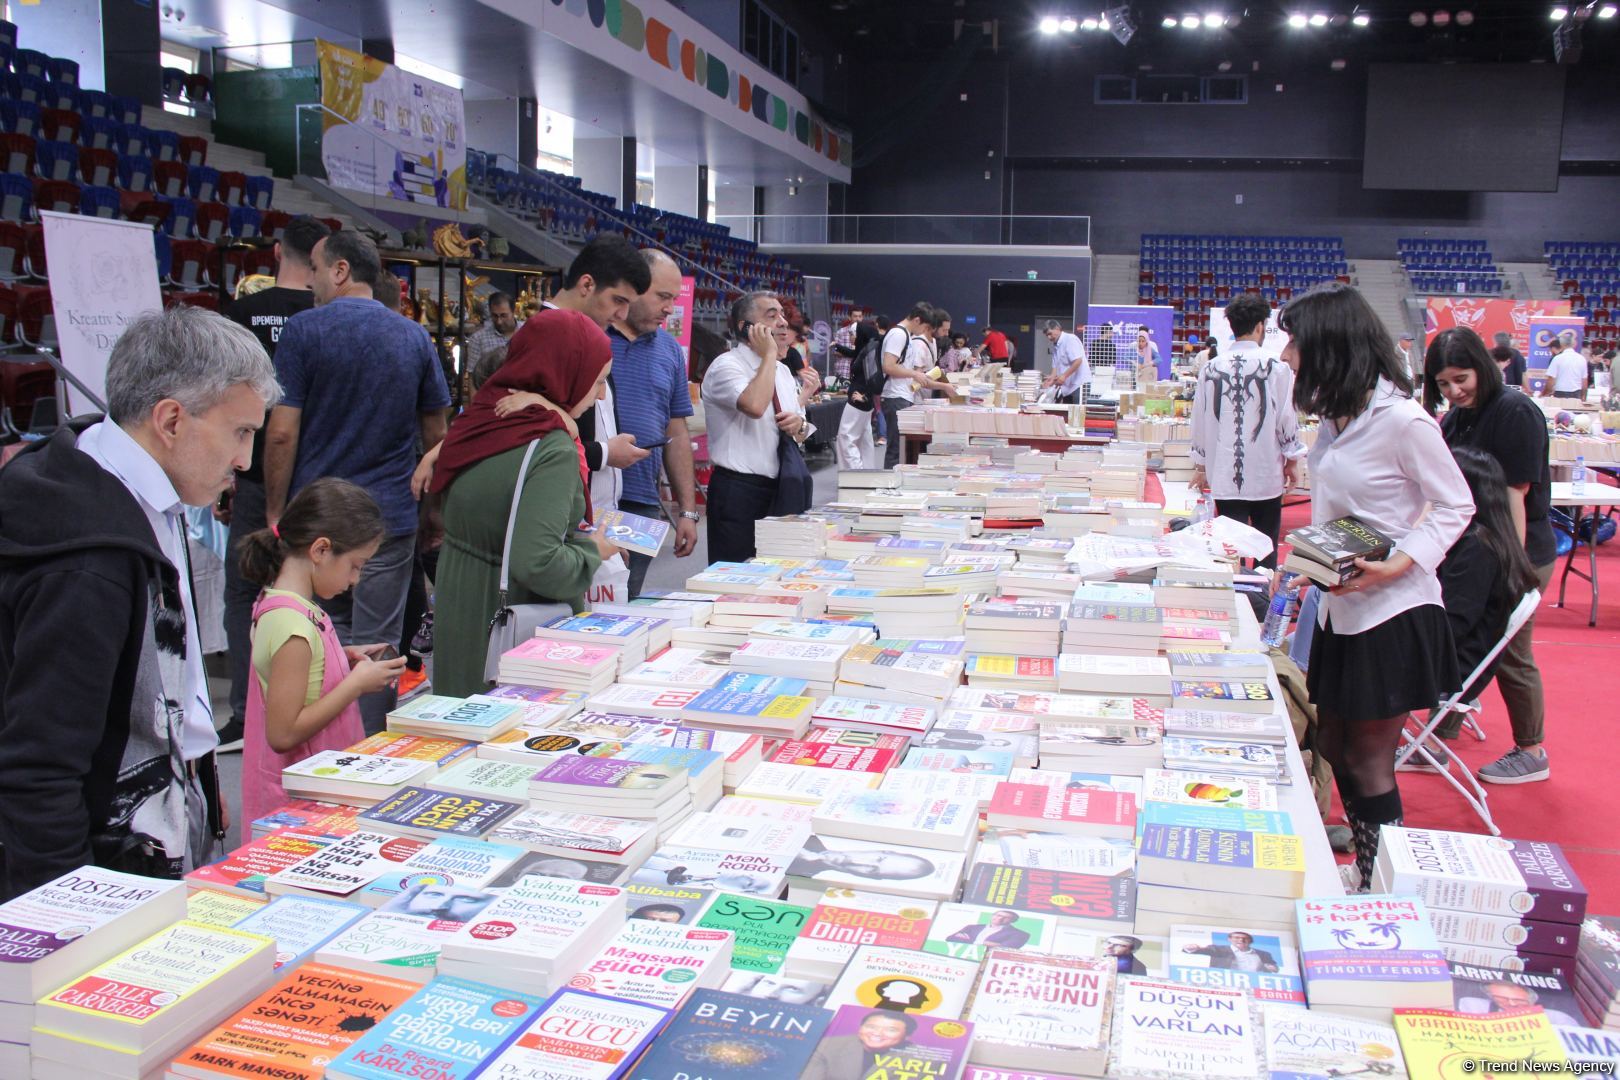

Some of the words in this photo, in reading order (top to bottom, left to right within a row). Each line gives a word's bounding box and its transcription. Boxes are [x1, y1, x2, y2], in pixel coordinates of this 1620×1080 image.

[67, 310, 113, 326] Kreativ
[652, 690, 700, 707] TED
[443, 702, 492, 722] GÜCÜ
[410, 797, 462, 827] GÜCÜ
[433, 797, 484, 831] AĞILIN
[436, 845, 496, 864] YADDAŞ
[1196, 829, 1214, 863] QADINLAR
[1407, 831, 1444, 873] DOSTLARI
[317, 853, 364, 867] TINLA
[413, 853, 493, 875] HAQQINDA
[718, 861, 784, 874] ROBOT
[1523, 851, 1544, 876] DALE
[1531, 842, 1573, 889] CARNEGIE
[55, 876, 160, 901] DOSTLARI
[521, 877, 574, 893] Valeri
[626, 884, 704, 900] Alibaba
[498, 898, 583, 918] Stressə
[508, 889, 607, 908] Sinelnikov
[1329, 911, 1420, 922] həftəsi
[475, 922, 516, 934] STOP
[628, 922, 682, 939] Valeri
[617, 932, 717, 954] Sinelnikov
[195, 949, 225, 964] Son
[604, 946, 705, 967] Məqsədin
[863, 955, 966, 977] incognito
[588, 959, 666, 977] gücü
[1177, 968, 1252, 989] TƏSİR
[1449, 964, 1508, 984] LARRY
[1510, 972, 1562, 991] KING
[93, 982, 153, 1001] DALE
[297, 973, 364, 994] VECİNƏ
[55, 989, 159, 1019] CARNEGIE
[267, 994, 316, 1011] İNCƏ
[281, 985, 394, 1013] ALMAMAĞIN
[416, 993, 480, 1017] XIRDA
[1139, 990, 1234, 1012] DÜŞÜN
[252, 1004, 328, 1026] SƏNƏTİ
[392, 1013, 454, 1036] DƏRD
[420, 1007, 515, 1037] ŞEYLƏRİ
[695, 1000, 813, 1034] BEYİN
[975, 1012, 1095, 1036] NAPOLEON
[1174, 1007, 1200, 1020] və
[538, 1015, 641, 1047] GÜCÜ
[1131, 1014, 1243, 1037] VARLAN
[223, 1031, 241, 1039] THE
[241, 1034, 271, 1045] SUBTLE
[227, 1038, 246, 1047] NOT
[246, 1042, 277, 1052] GIVING
[388, 1024, 492, 1060] ETMƏYİN
[189, 1053, 237, 1070] MARK
[238, 1062, 311, 1080] MANSON
[351, 1050, 457, 1080] KARLSON
[378, 1044, 400, 1056] Dr.
[404, 1048, 454, 1070] Riçard
[873, 1054, 948, 1075] VARLI
[1133, 1047, 1244, 1065] NAPOLEON
